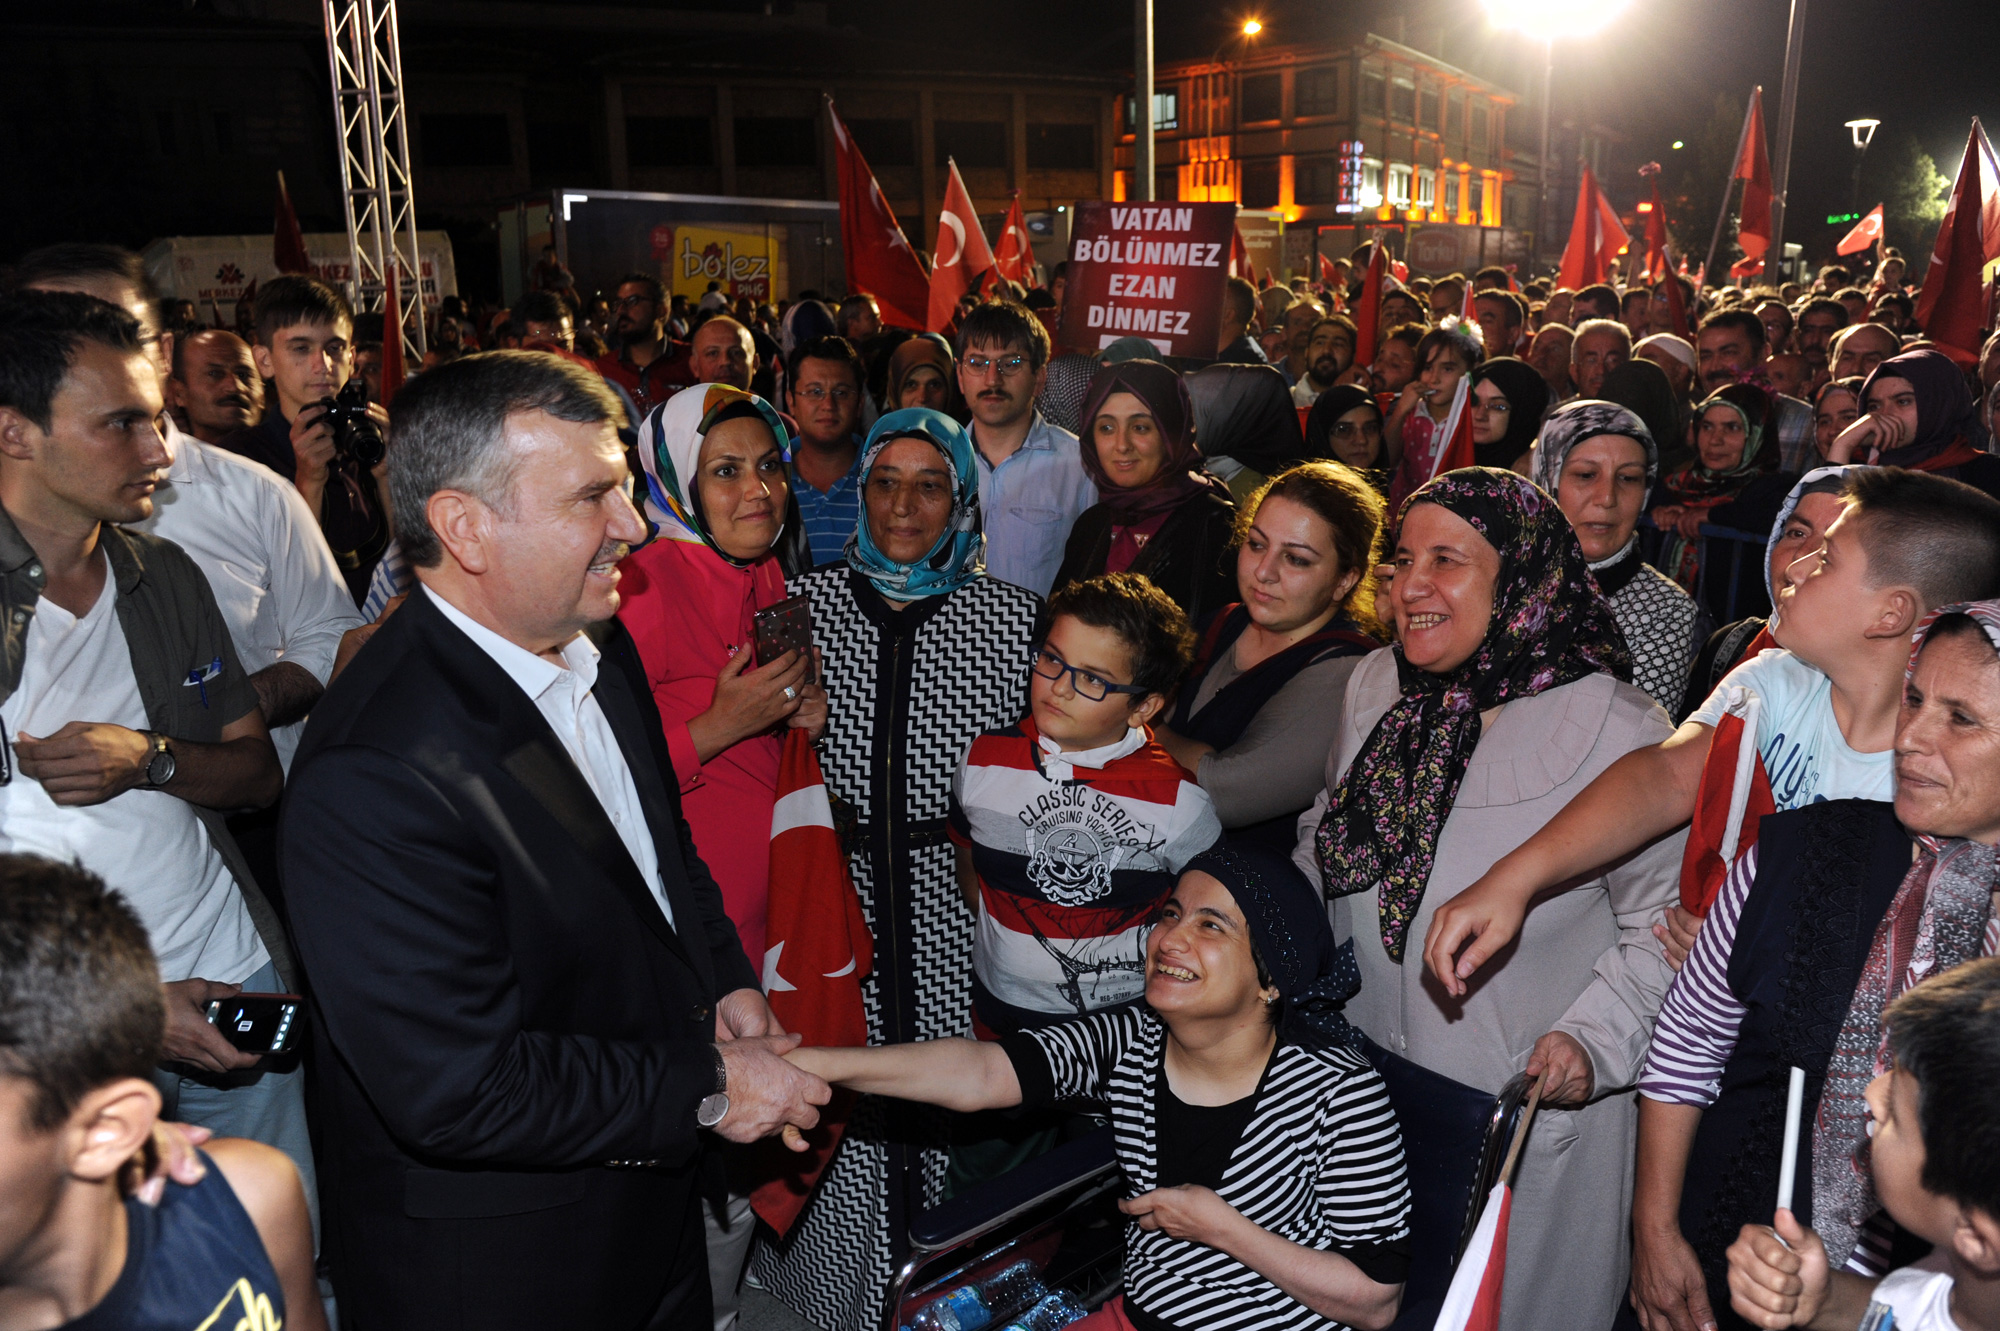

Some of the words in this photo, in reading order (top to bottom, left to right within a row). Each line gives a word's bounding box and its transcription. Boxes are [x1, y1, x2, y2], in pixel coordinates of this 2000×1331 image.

[1110, 207, 1194, 232] VATAN
[681, 236, 771, 283] bolez
[1073, 234, 1222, 268] BÖLÜNMEZ
[1107, 273, 1177, 300] EZAN
[1086, 300, 1192, 336] DİNMEZ
[1018, 785, 1088, 828] CLASSIC
[1091, 793, 1140, 847] SERIES
[1035, 810, 1083, 836] CRUISING
[1084, 814, 1116, 848] YACHTS
